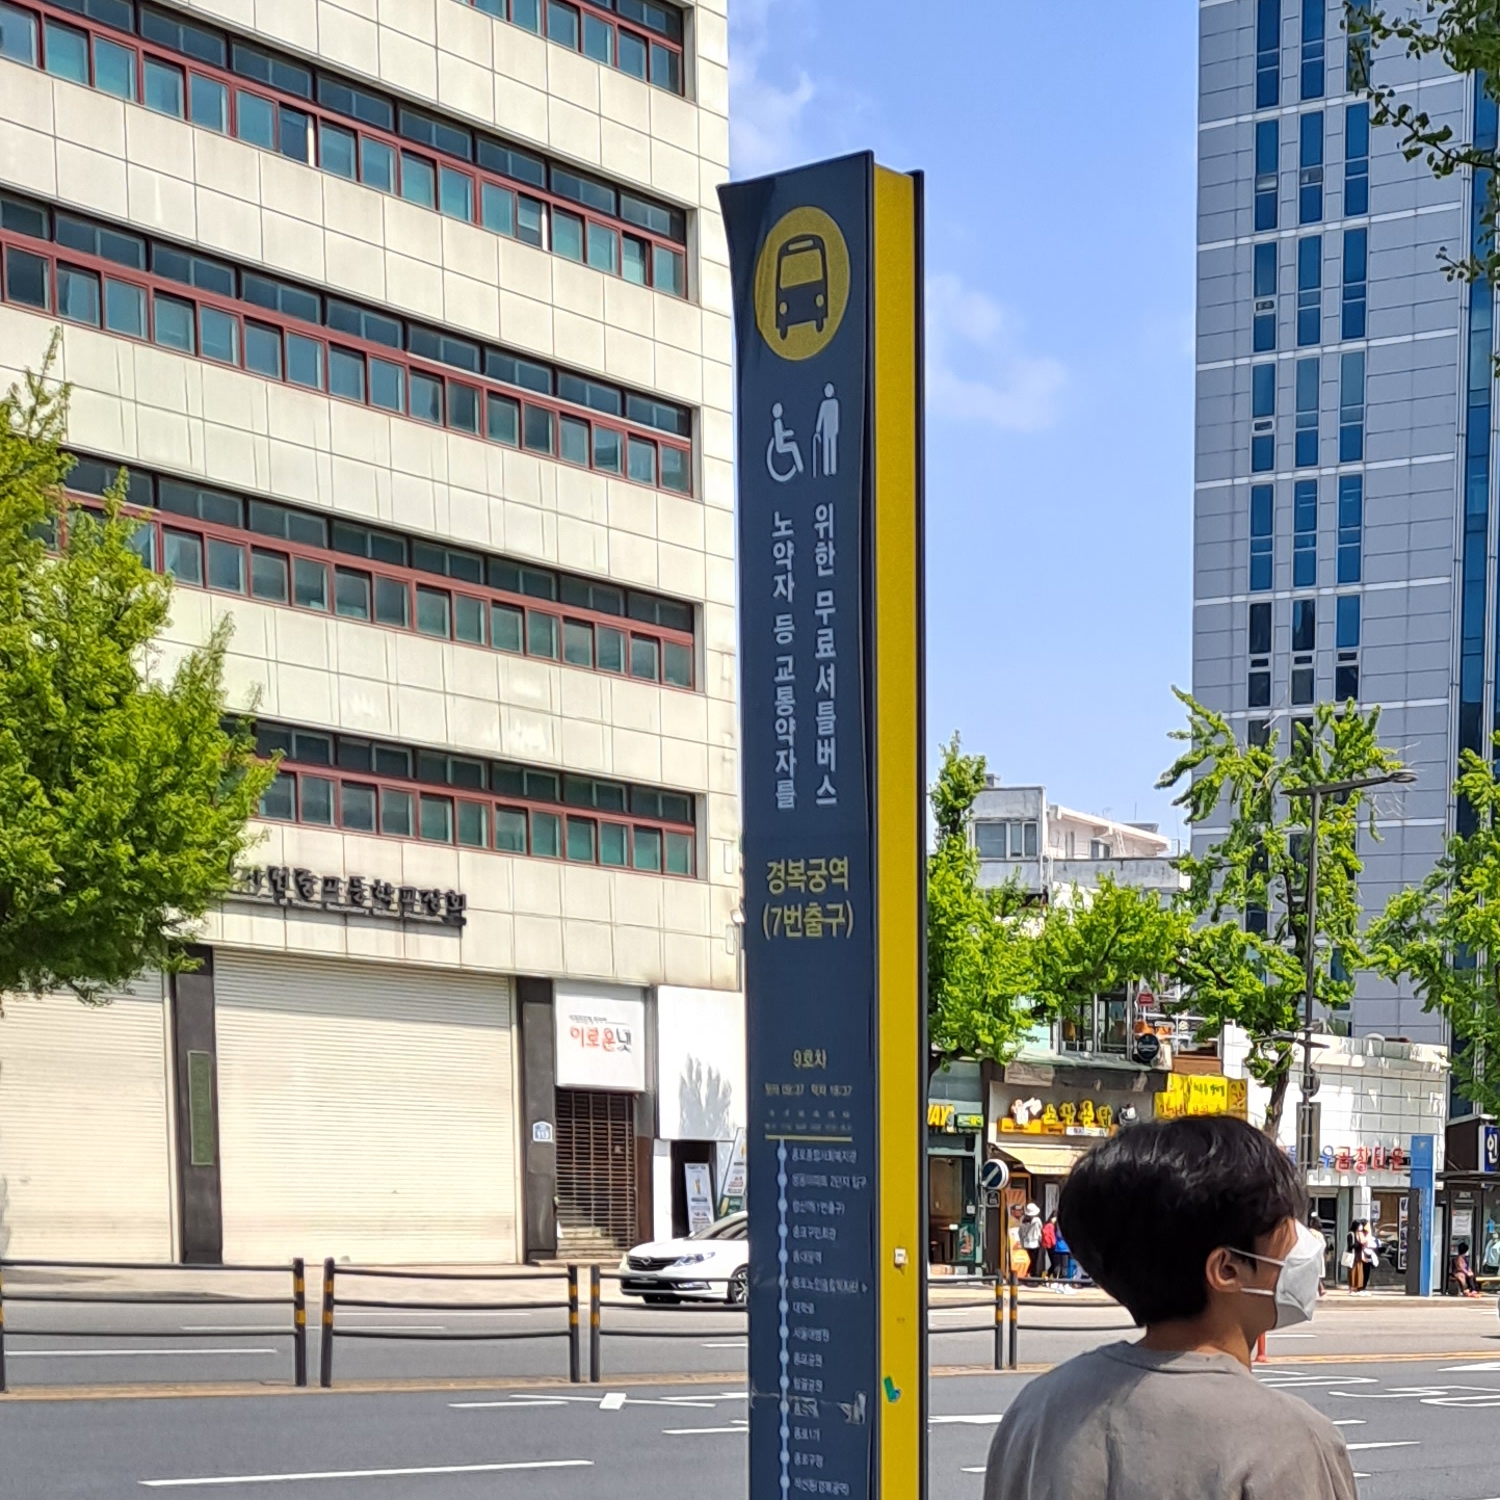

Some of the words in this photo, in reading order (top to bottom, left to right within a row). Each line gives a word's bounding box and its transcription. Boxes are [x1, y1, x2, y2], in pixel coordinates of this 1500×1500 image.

[772, 511, 795, 602] 노약자
[813, 503, 836, 577] 위한
[773, 613, 795, 645] 등
[773, 655, 797, 810] 교통약자를
[814, 590, 838, 807] 무료셔틀버스
[766, 856, 849, 895] 경복궁역
[762, 899, 854, 940] (7번출구)
